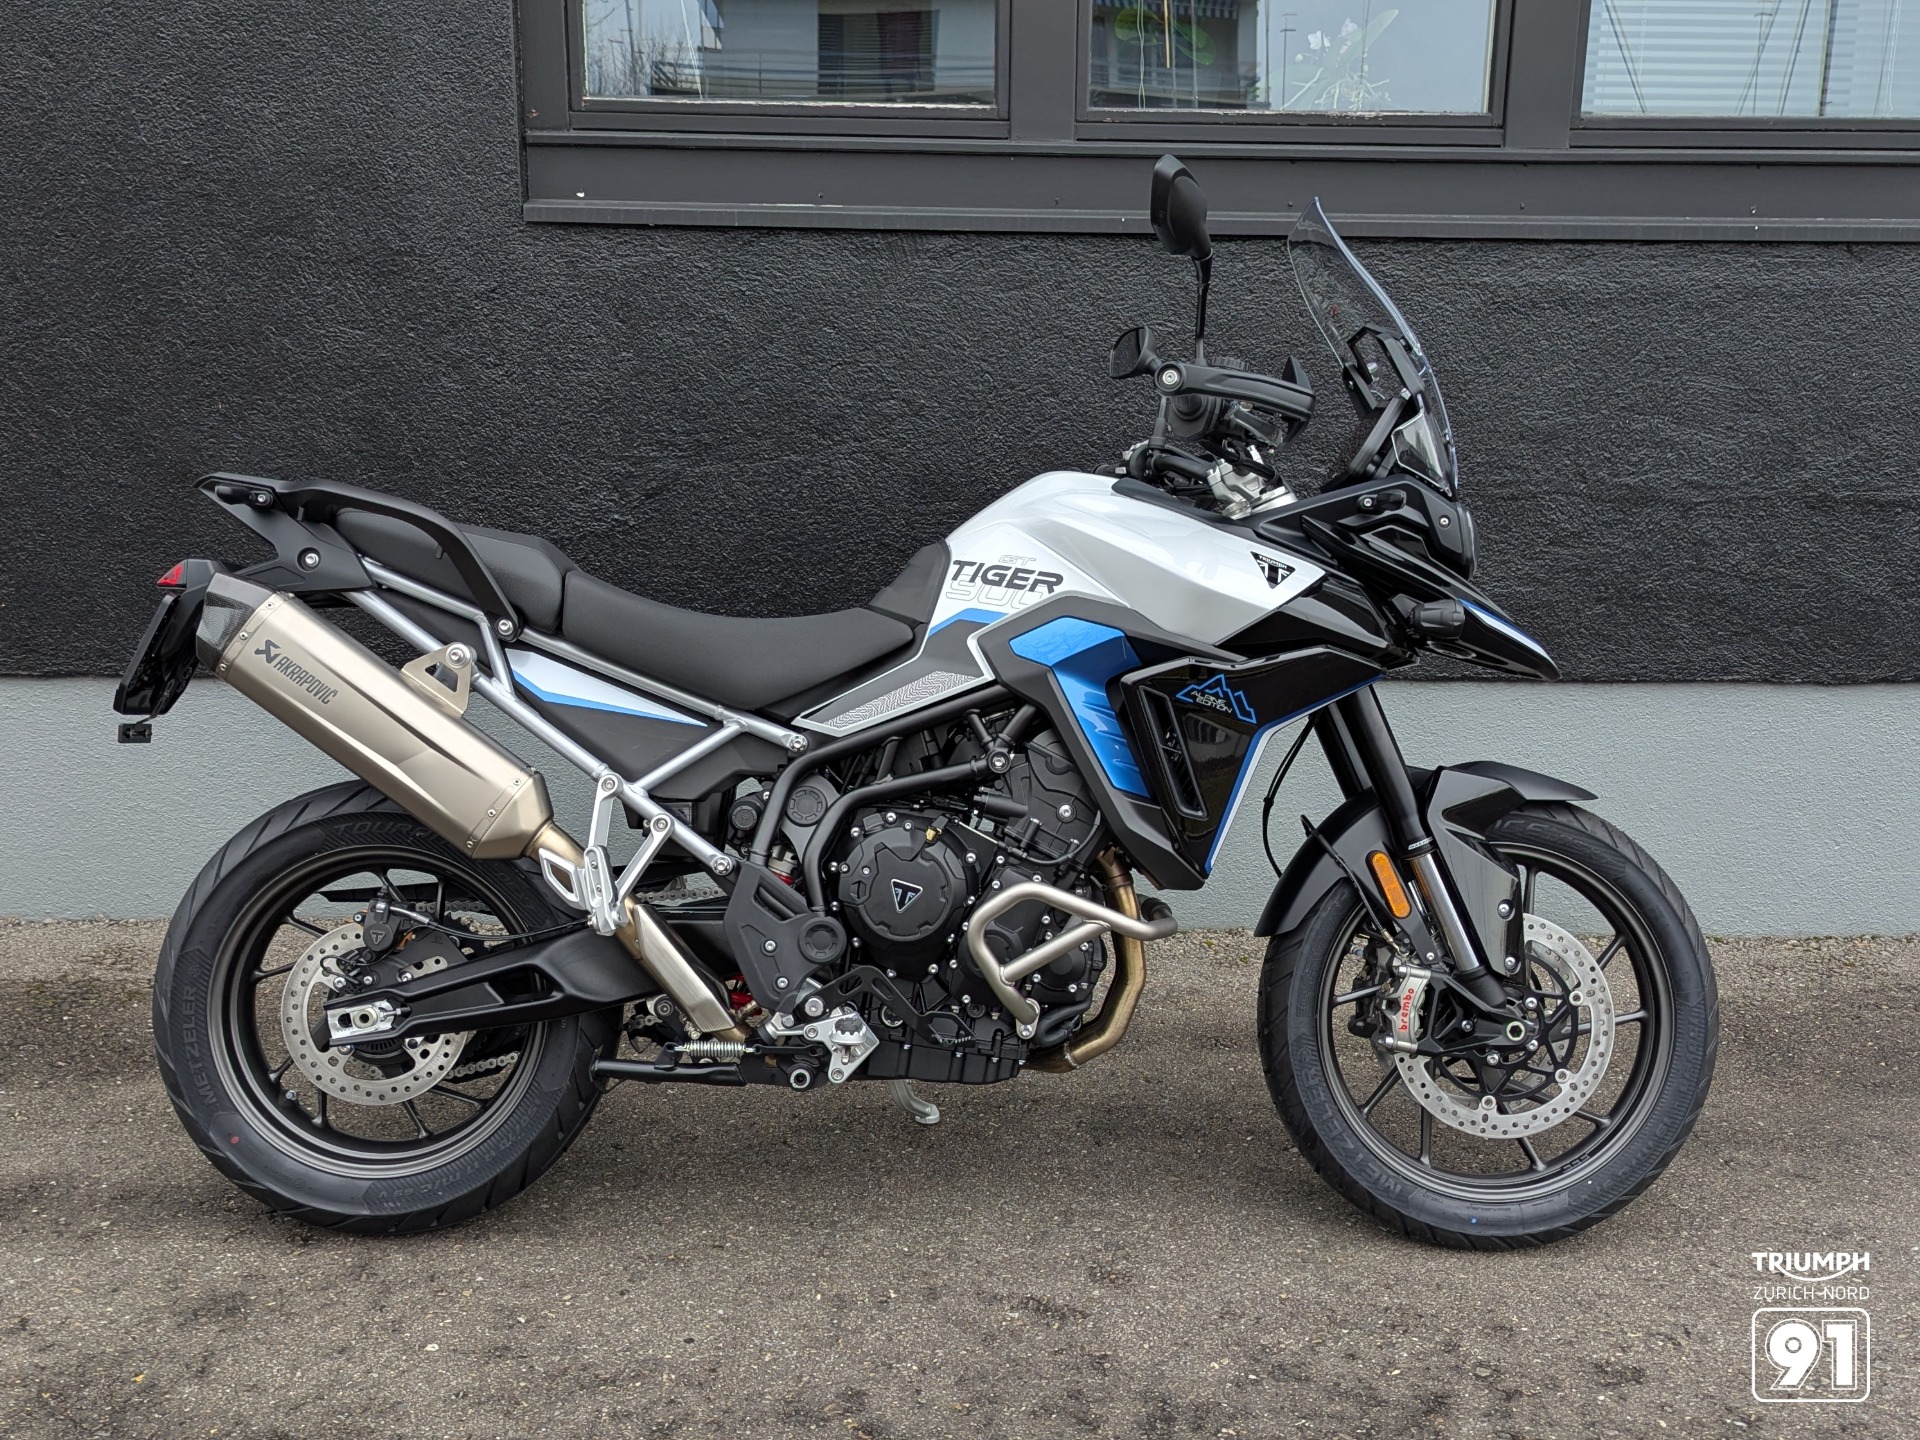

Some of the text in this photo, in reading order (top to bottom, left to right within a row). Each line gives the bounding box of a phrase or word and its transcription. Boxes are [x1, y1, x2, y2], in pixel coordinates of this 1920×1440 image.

[952, 560, 1064, 594] TIGER
[998, 554, 1037, 566] GT
[1196, 697, 1232, 713] EDITION
[1398, 988, 1415, 1031] brembo
[183, 985, 219, 1106] METZELER
[1300, 1065, 1405, 1200] METZELER
